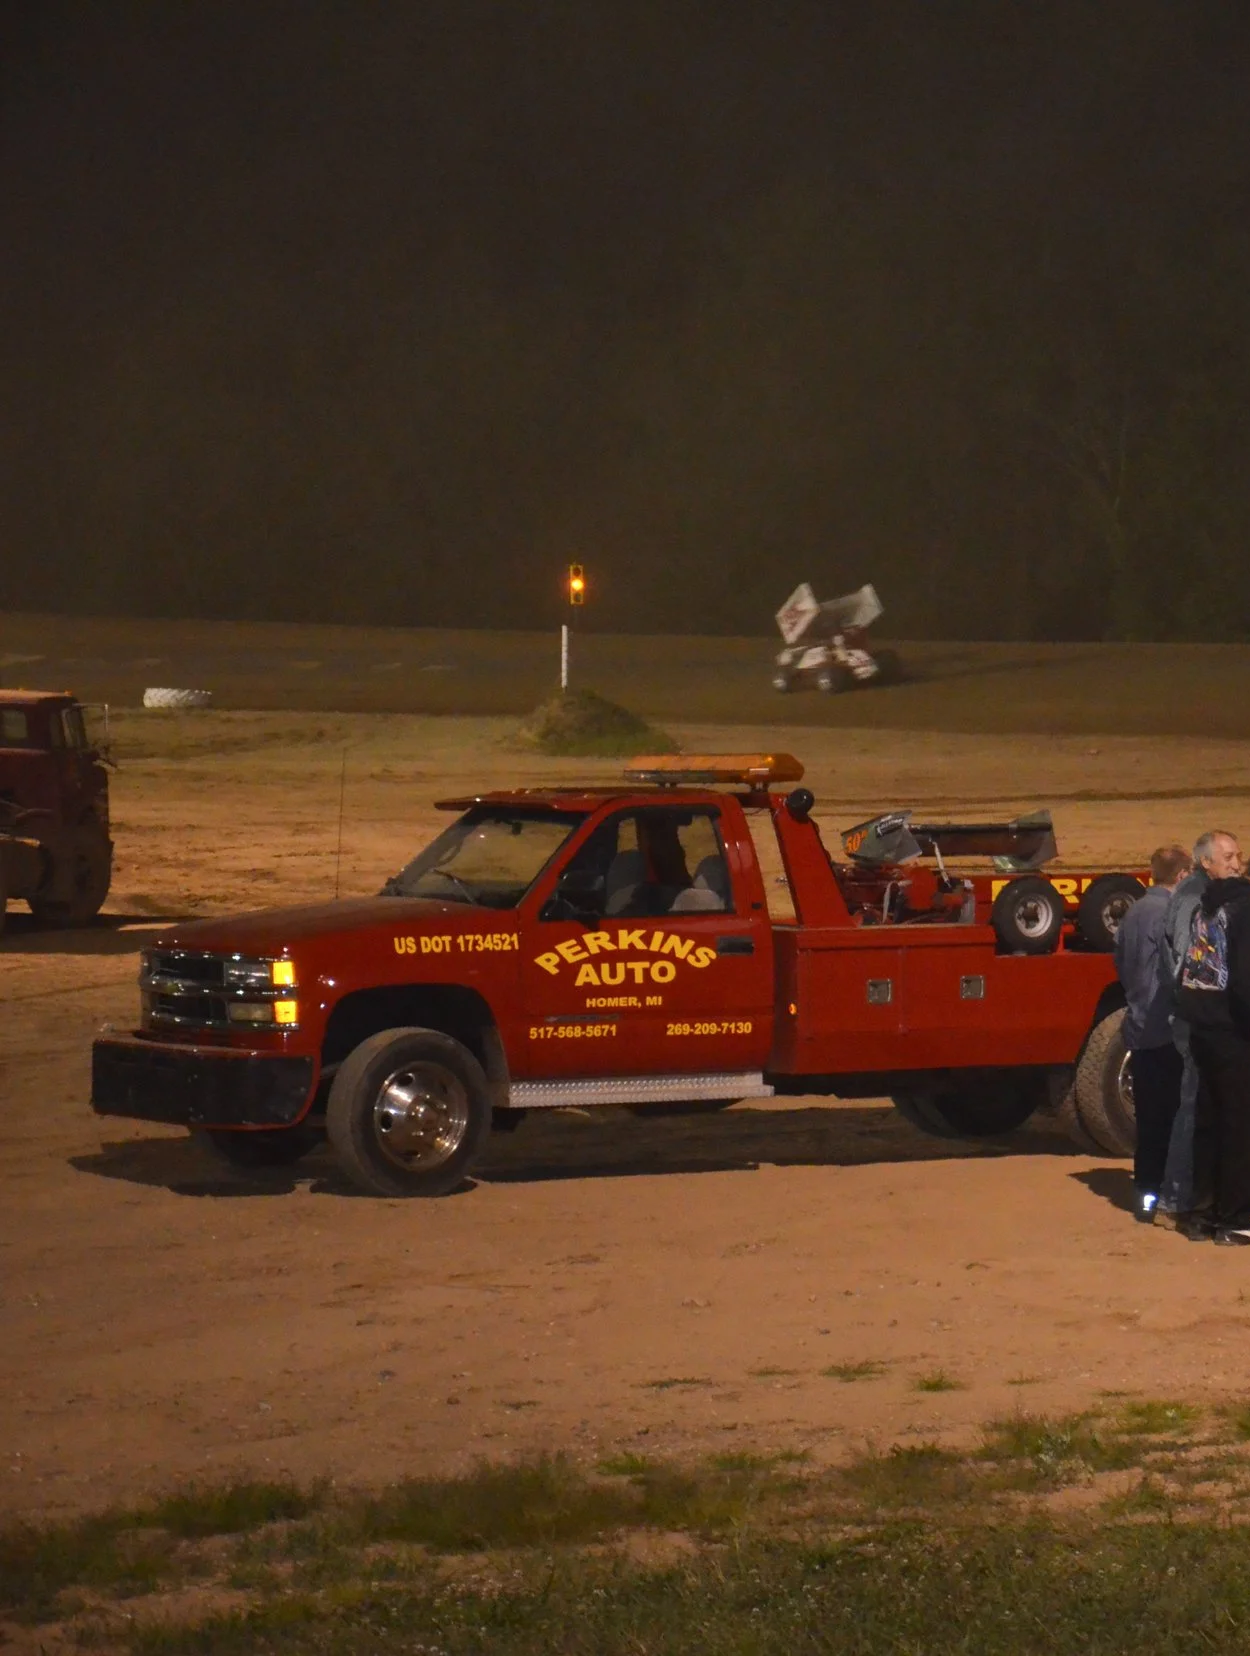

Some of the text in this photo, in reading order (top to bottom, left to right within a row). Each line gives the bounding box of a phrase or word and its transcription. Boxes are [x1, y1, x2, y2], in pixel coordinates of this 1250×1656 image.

[393, 933, 520, 954] US DOT 1734521
[534, 929, 717, 975] PERKINS
[575, 961, 676, 987] AUTO
[586, 996, 663, 1009] HOMER, MI
[529, 1022, 753, 1040] 517-568-5671 269-209-7130
